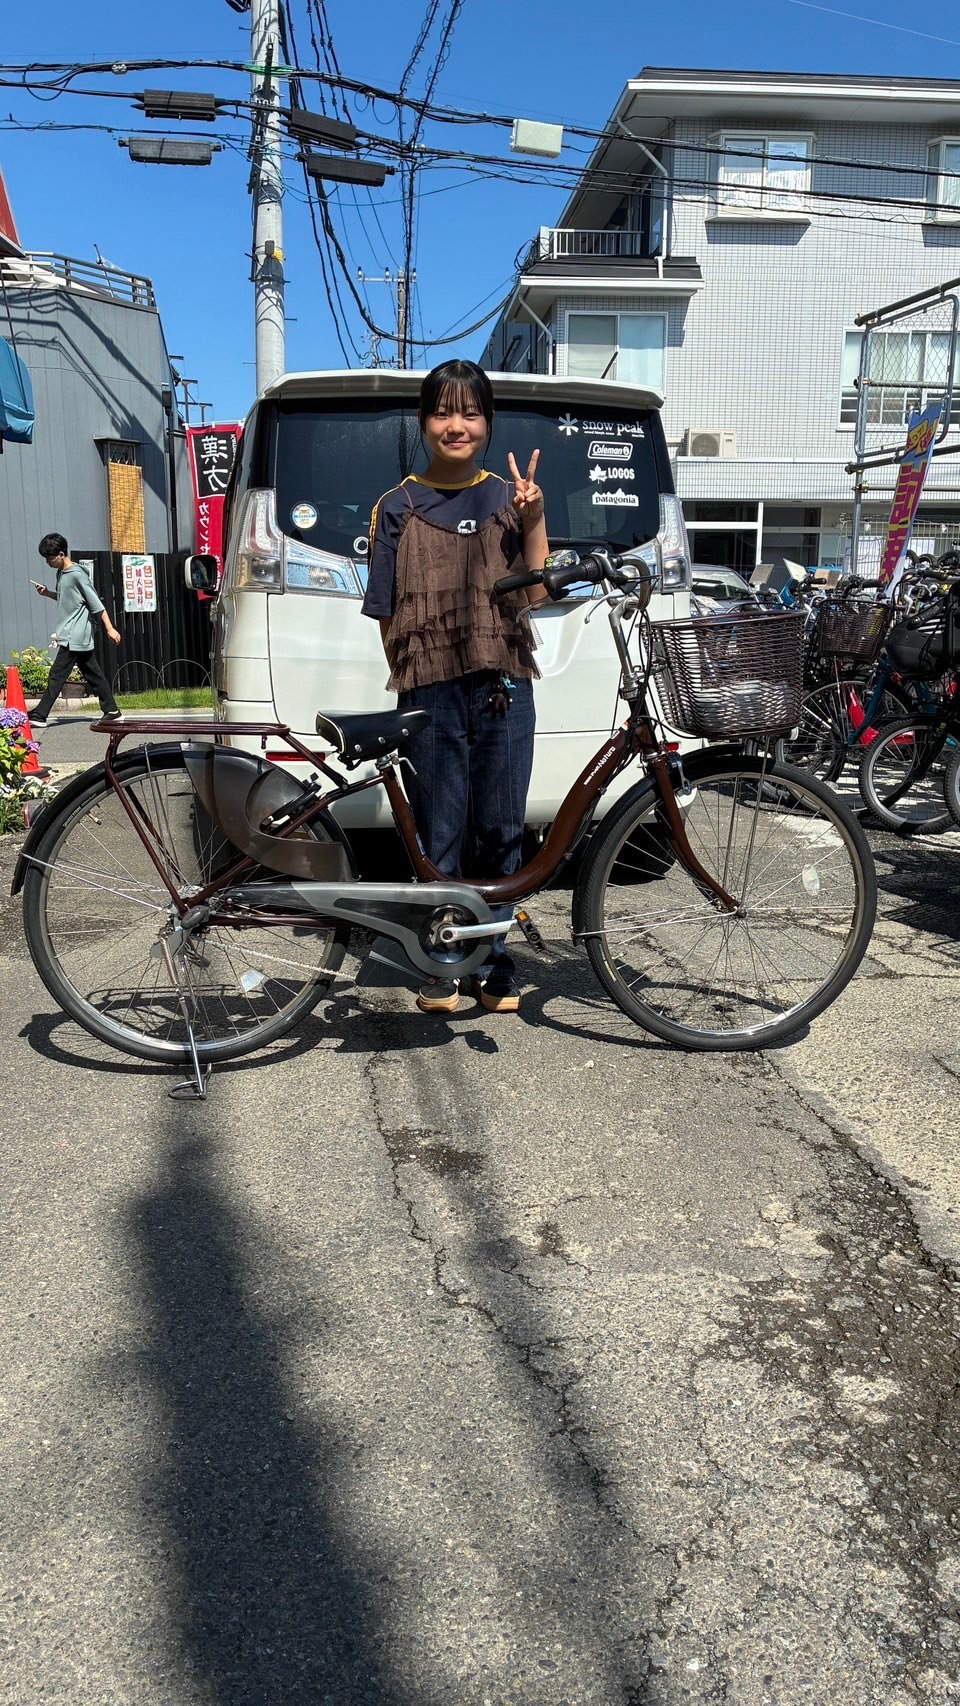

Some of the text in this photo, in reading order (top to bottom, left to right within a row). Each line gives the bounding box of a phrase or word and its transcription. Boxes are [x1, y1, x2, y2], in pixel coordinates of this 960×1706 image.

[582, 420, 614, 431] snow
[617, 421, 644, 436] peak
[592, 444, 622, 455] Coleman
[608, 467, 635, 480] LOGOS
[595, 495, 636, 504] patagonia
[598, 746, 616, 768] Natura
